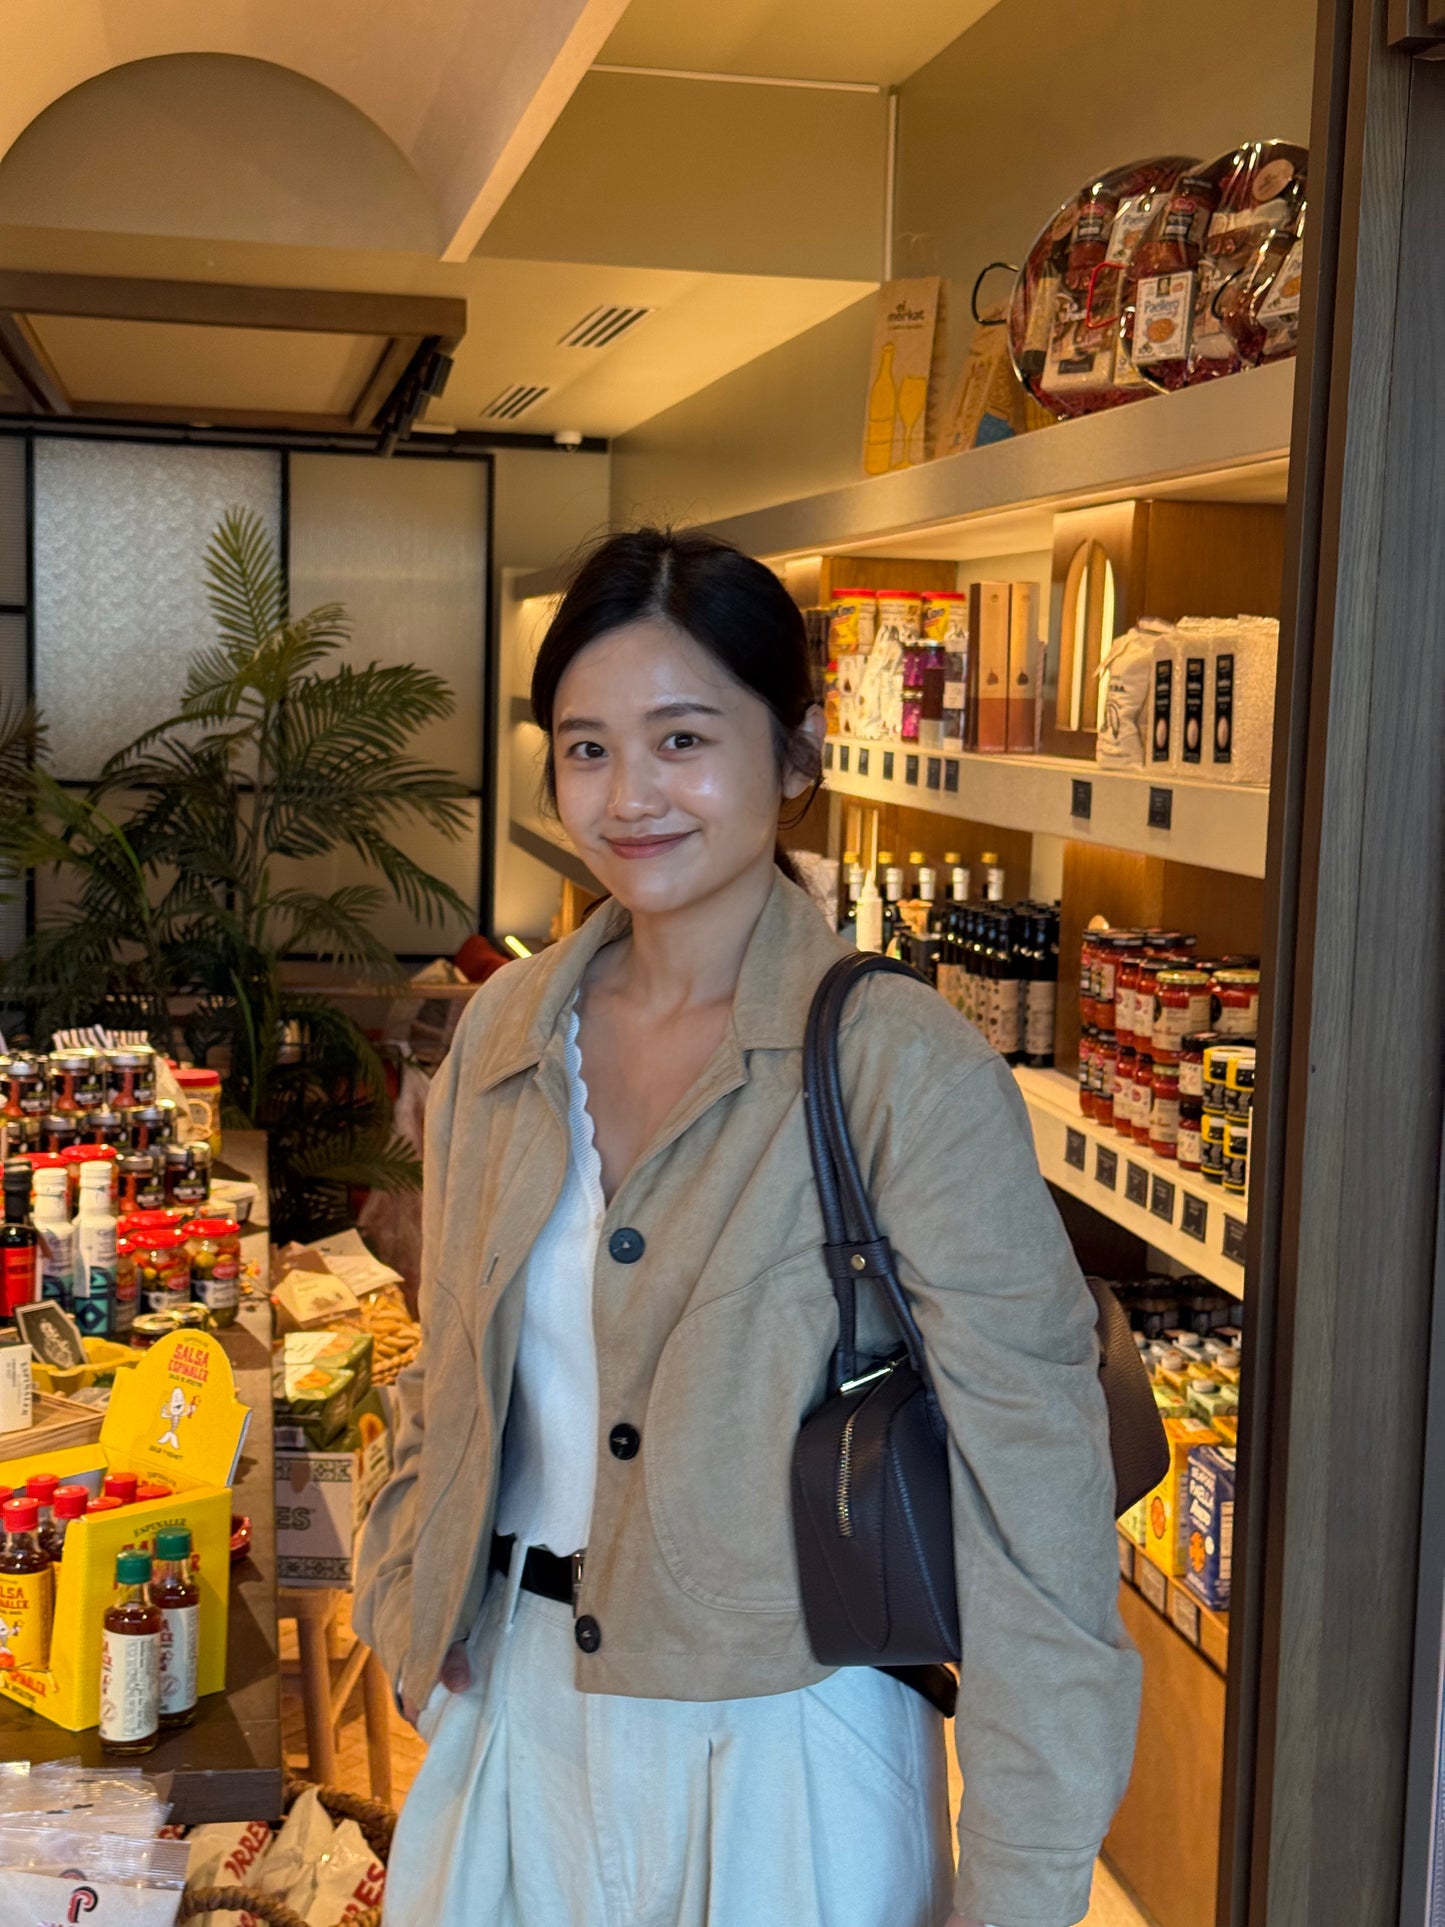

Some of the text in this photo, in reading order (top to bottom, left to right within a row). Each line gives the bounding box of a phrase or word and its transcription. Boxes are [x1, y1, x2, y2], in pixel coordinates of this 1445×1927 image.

[173, 1343, 210, 1368] SALSA
[276, 1506, 311, 1531] ES
[0, 1585, 24, 1599] LSA
